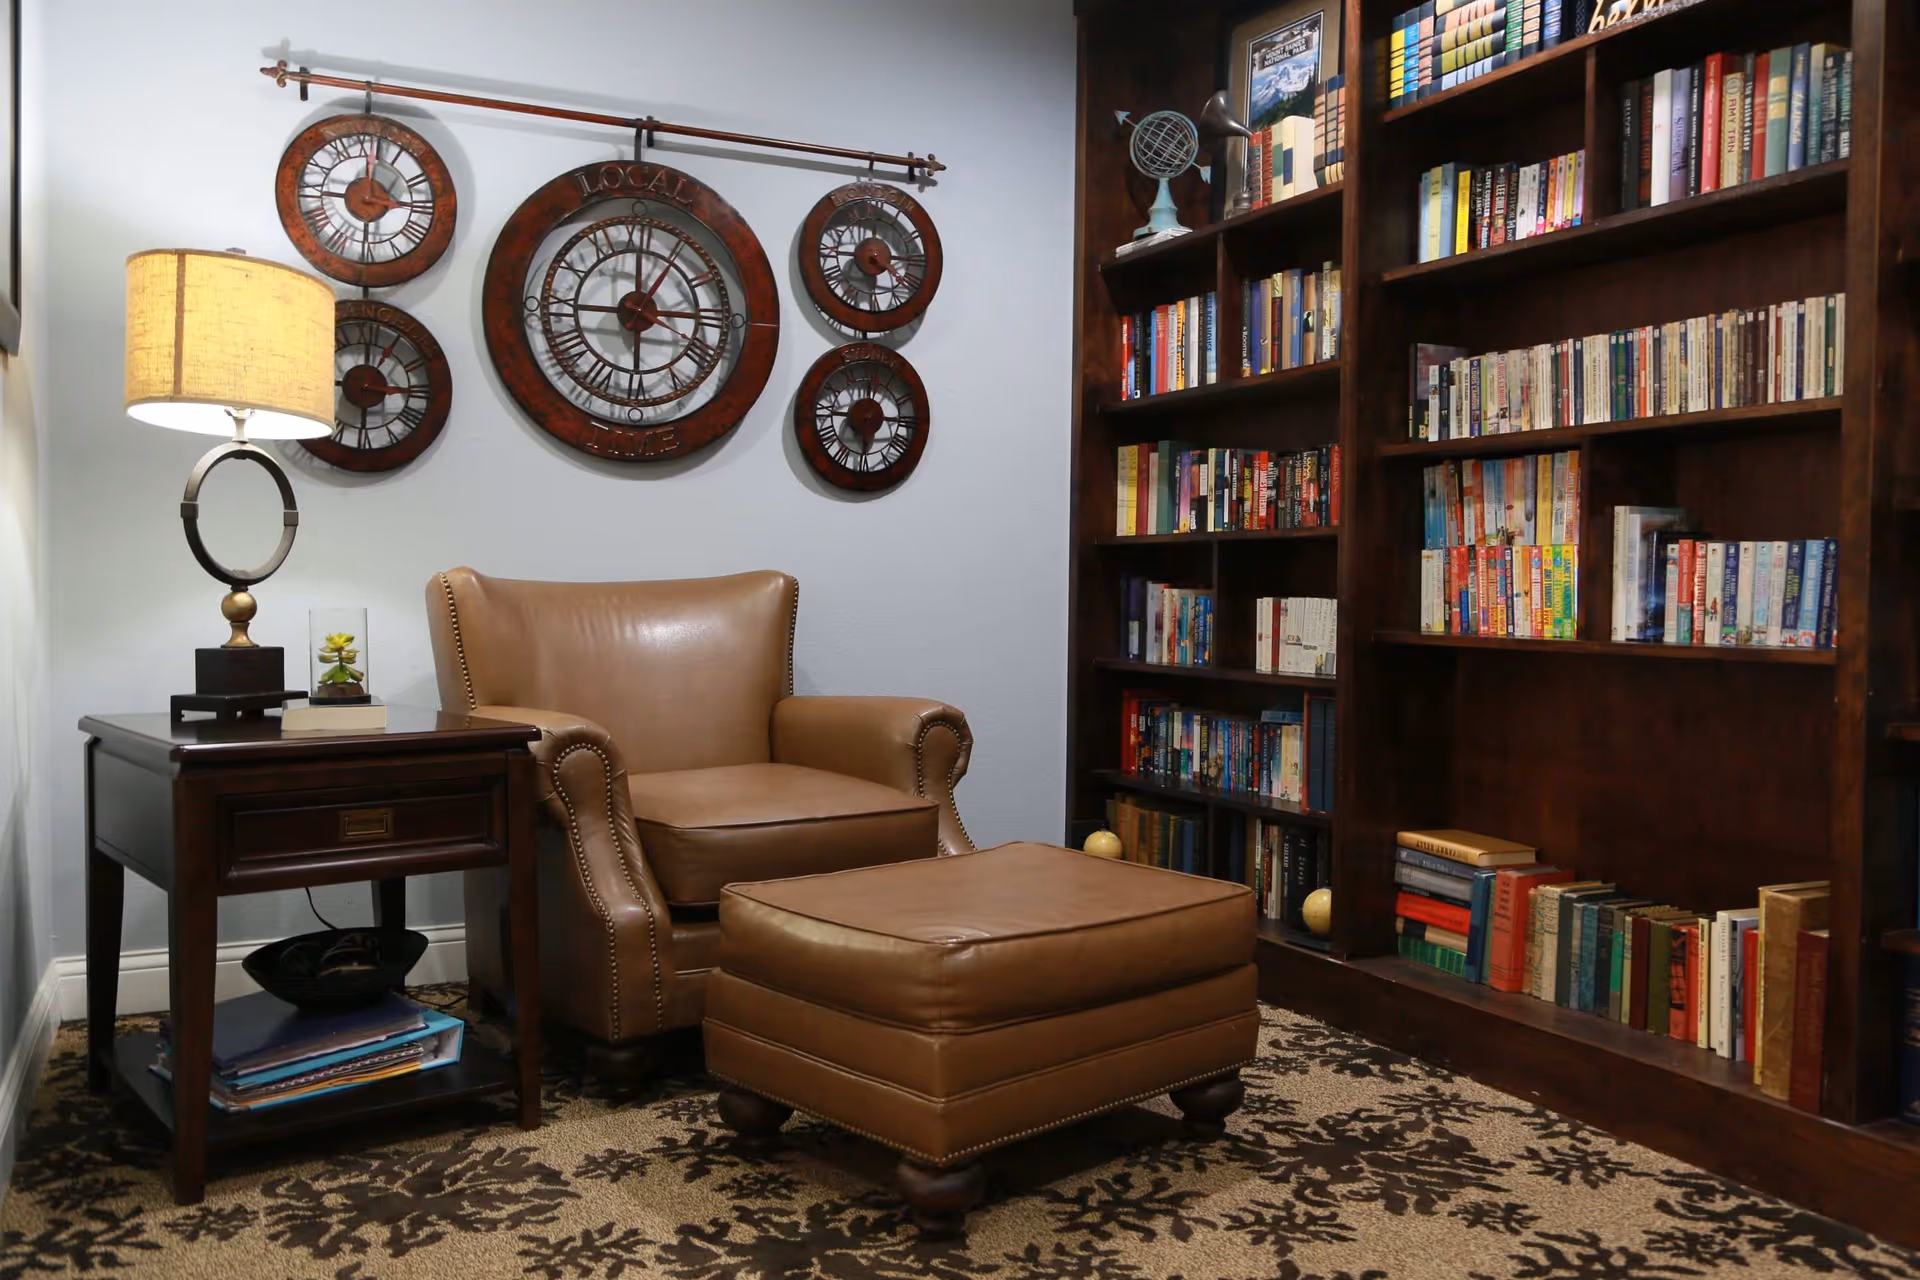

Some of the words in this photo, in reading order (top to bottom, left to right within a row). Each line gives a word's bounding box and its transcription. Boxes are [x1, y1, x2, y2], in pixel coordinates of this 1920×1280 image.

[1264, 51, 1292, 67] NATIONAL
[1292, 44, 1307, 58] PARK
[1265, 47, 1285, 60] MOUNT
[1727, 98, 1737, 123] AMY
[1727, 129, 1737, 154] TAN
[575, 164, 693, 205] LOCAL
[1484, 170, 1492, 190] CLIVE
[1495, 183, 1506, 197] LEE
[1483, 189, 1491, 218] CUSSLER
[1497, 362, 1507, 380] LOUIS
[1259, 470, 1268, 488] JAMES
